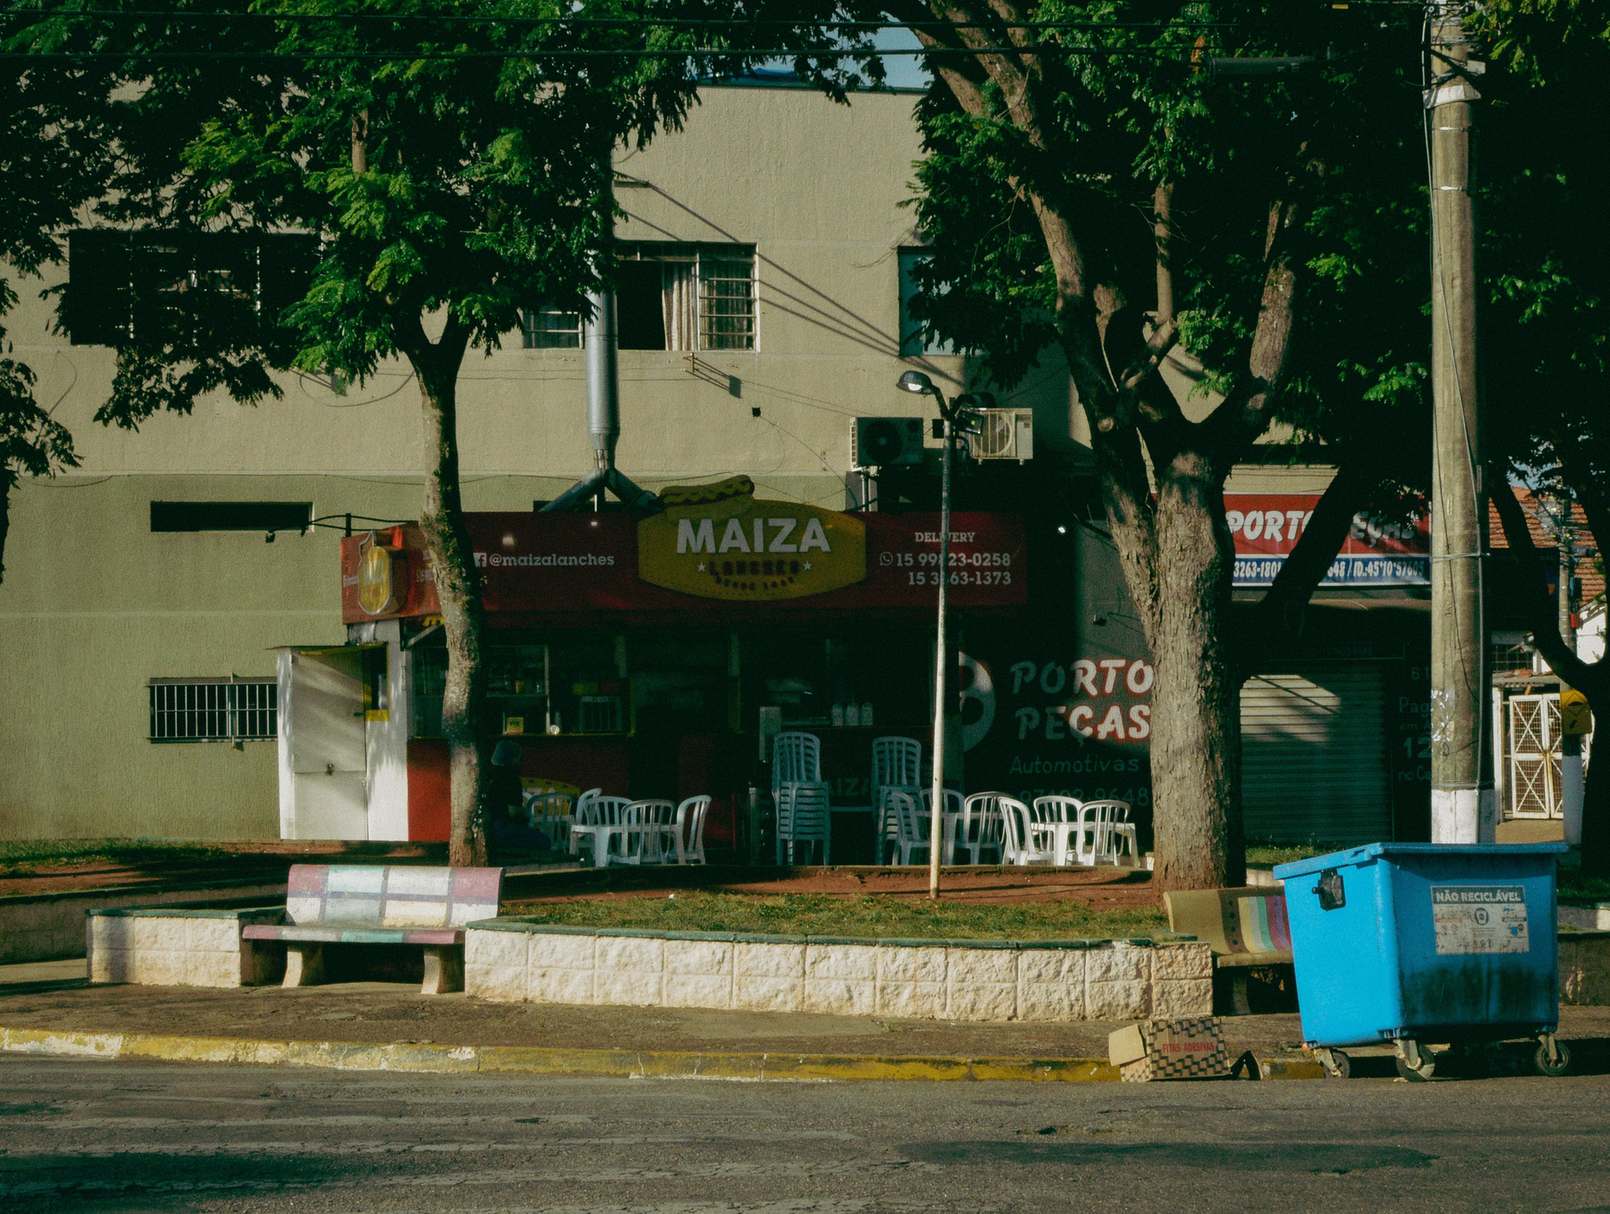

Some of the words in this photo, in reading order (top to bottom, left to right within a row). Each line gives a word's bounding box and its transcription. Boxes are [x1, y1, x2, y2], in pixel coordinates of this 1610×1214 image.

[676, 518, 831, 553] MAIZA
[489, 553, 615, 567] @maizalanches
[897, 553, 914, 566] 15
[909, 571, 926, 585] 15
[930, 571, 1011, 585] 363-1373
[1010, 659, 1152, 696] PORTO
[1015, 704, 1150, 747] PEÇAS
[1010, 754, 1139, 774] Automotivas
[1436, 889, 1459, 902] NÃO
[1461, 889, 1522, 902] RECICLÁVEL
